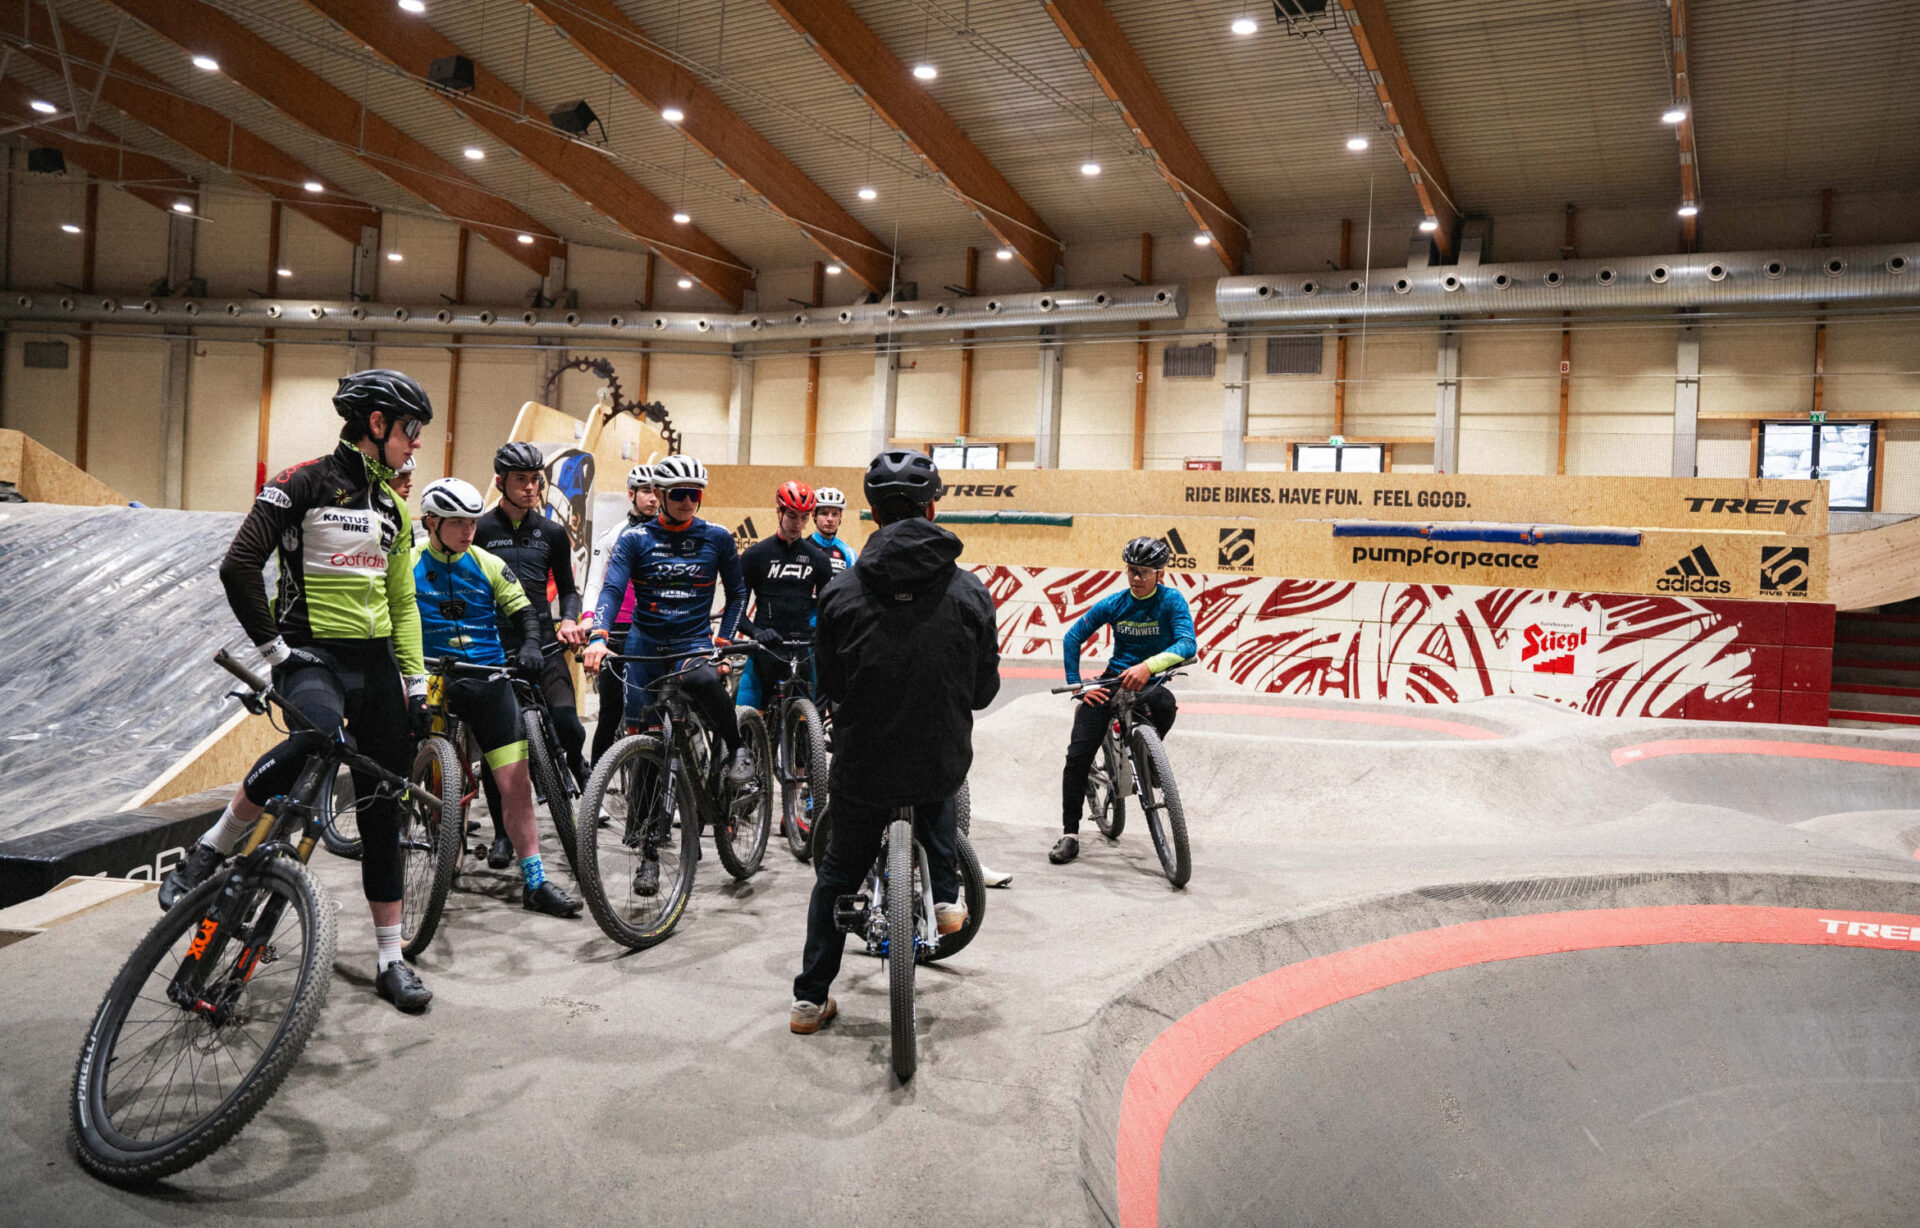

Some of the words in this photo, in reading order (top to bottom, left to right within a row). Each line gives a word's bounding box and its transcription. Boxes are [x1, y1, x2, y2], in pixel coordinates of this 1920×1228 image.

[942, 484, 1018, 497] TREK
[1185, 486, 1221, 502] RIDE
[1225, 487, 1275, 504] BIKES.
[1279, 488, 1321, 504] HAVE
[1325, 489, 1362, 505] FUN.
[1374, 490, 1413, 506] FEEL
[1417, 491, 1471, 508] GOOD.
[1684, 497, 1812, 515] TREK
[323, 513, 369, 524] KAKTUS
[343, 523, 369, 533] BIKE
[330, 552, 385, 569] Cofidis
[1166, 554, 1197, 569] das
[1353, 546, 1539, 569] pumpforpeace
[1656, 575, 1731, 593] adidas
[1521, 622, 1587, 663] Stiegl
[186, 916, 218, 961] FOX
[77, 1034, 97, 1101] PIRELLI
